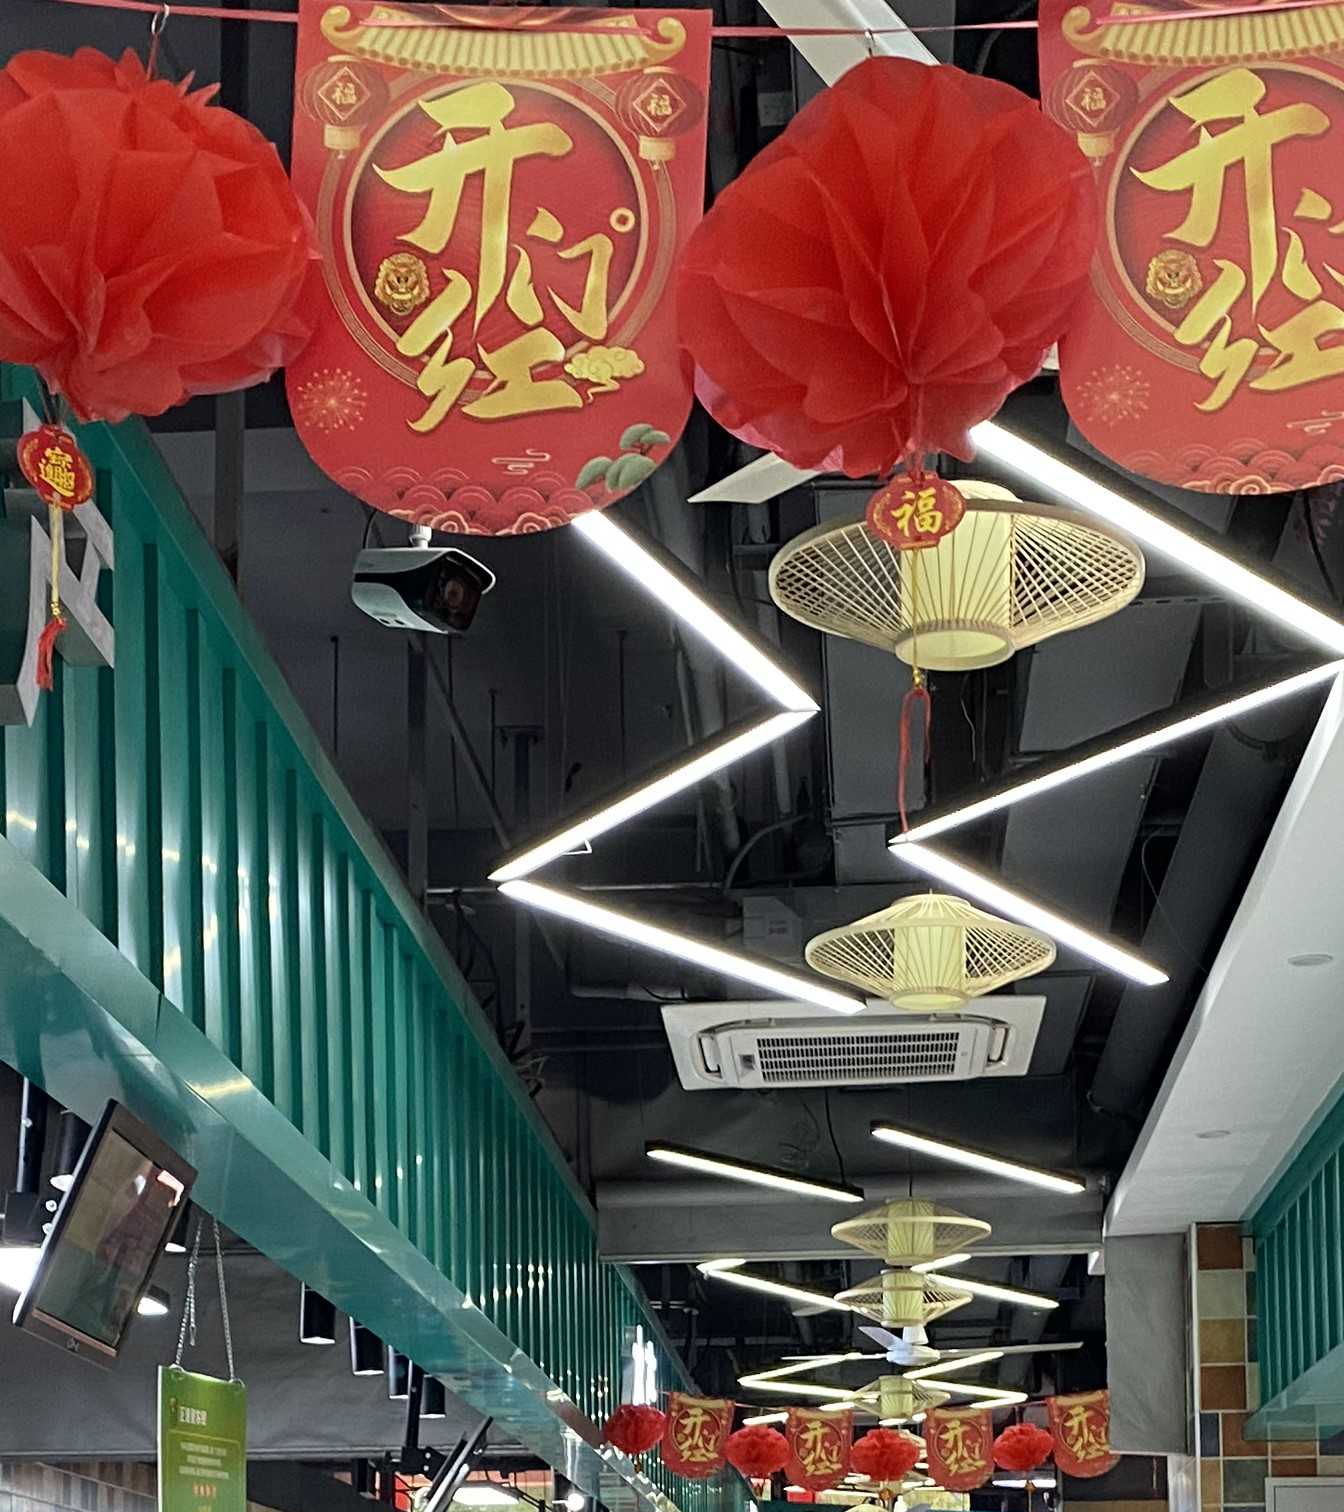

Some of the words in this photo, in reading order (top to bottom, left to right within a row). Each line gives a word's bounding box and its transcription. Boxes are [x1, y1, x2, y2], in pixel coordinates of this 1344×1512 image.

[373, 80, 615, 434] 开门红
[891, 488, 943, 538] 福
